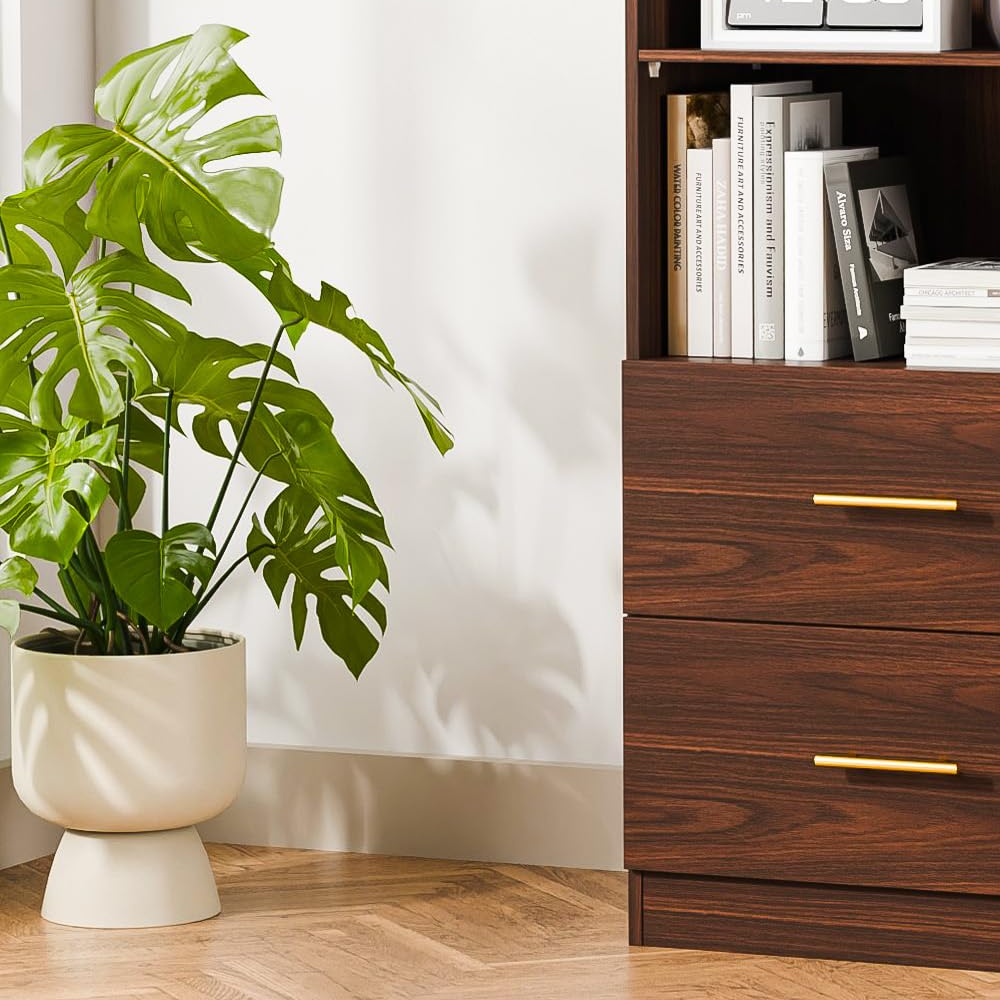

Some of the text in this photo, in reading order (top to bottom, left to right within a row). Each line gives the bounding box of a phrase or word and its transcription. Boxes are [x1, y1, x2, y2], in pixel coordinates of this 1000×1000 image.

[736, 11, 752, 21] pm
[673, 163, 683, 272] WATER COLOR PAINTING
[765, 121, 777, 299] Expressionism and Fauvism
[695, 228, 703, 245] AND
[737, 212, 745, 275] ACCESSORIES
[695, 245, 703, 294] ACCESSORIES
[917, 289, 943, 297] CHICAGO
